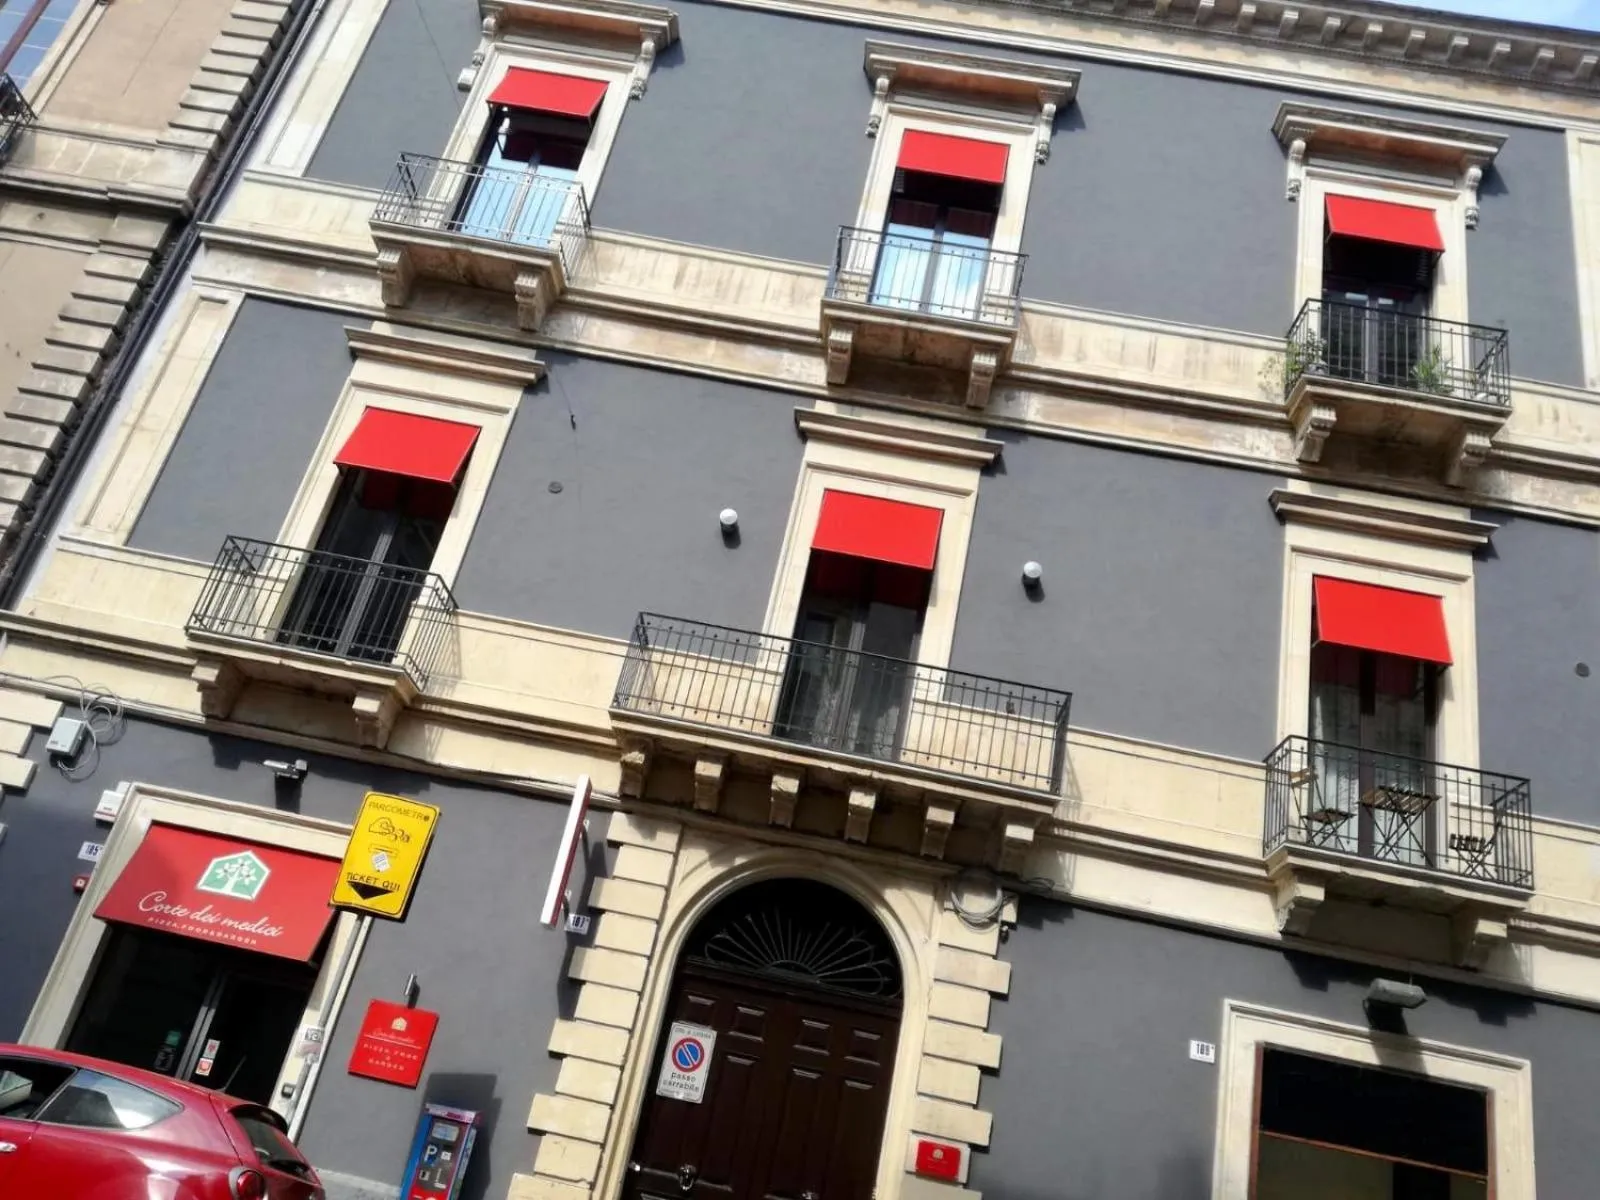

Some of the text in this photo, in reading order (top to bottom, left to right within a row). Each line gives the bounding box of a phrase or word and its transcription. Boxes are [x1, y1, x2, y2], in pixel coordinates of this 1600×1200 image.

[346, 872, 400, 892] TICKET QUI
[138, 890, 284, 937] Corte dei medici
[671, 1072, 697, 1082] passo
[424, 1144, 438, 1162] P
